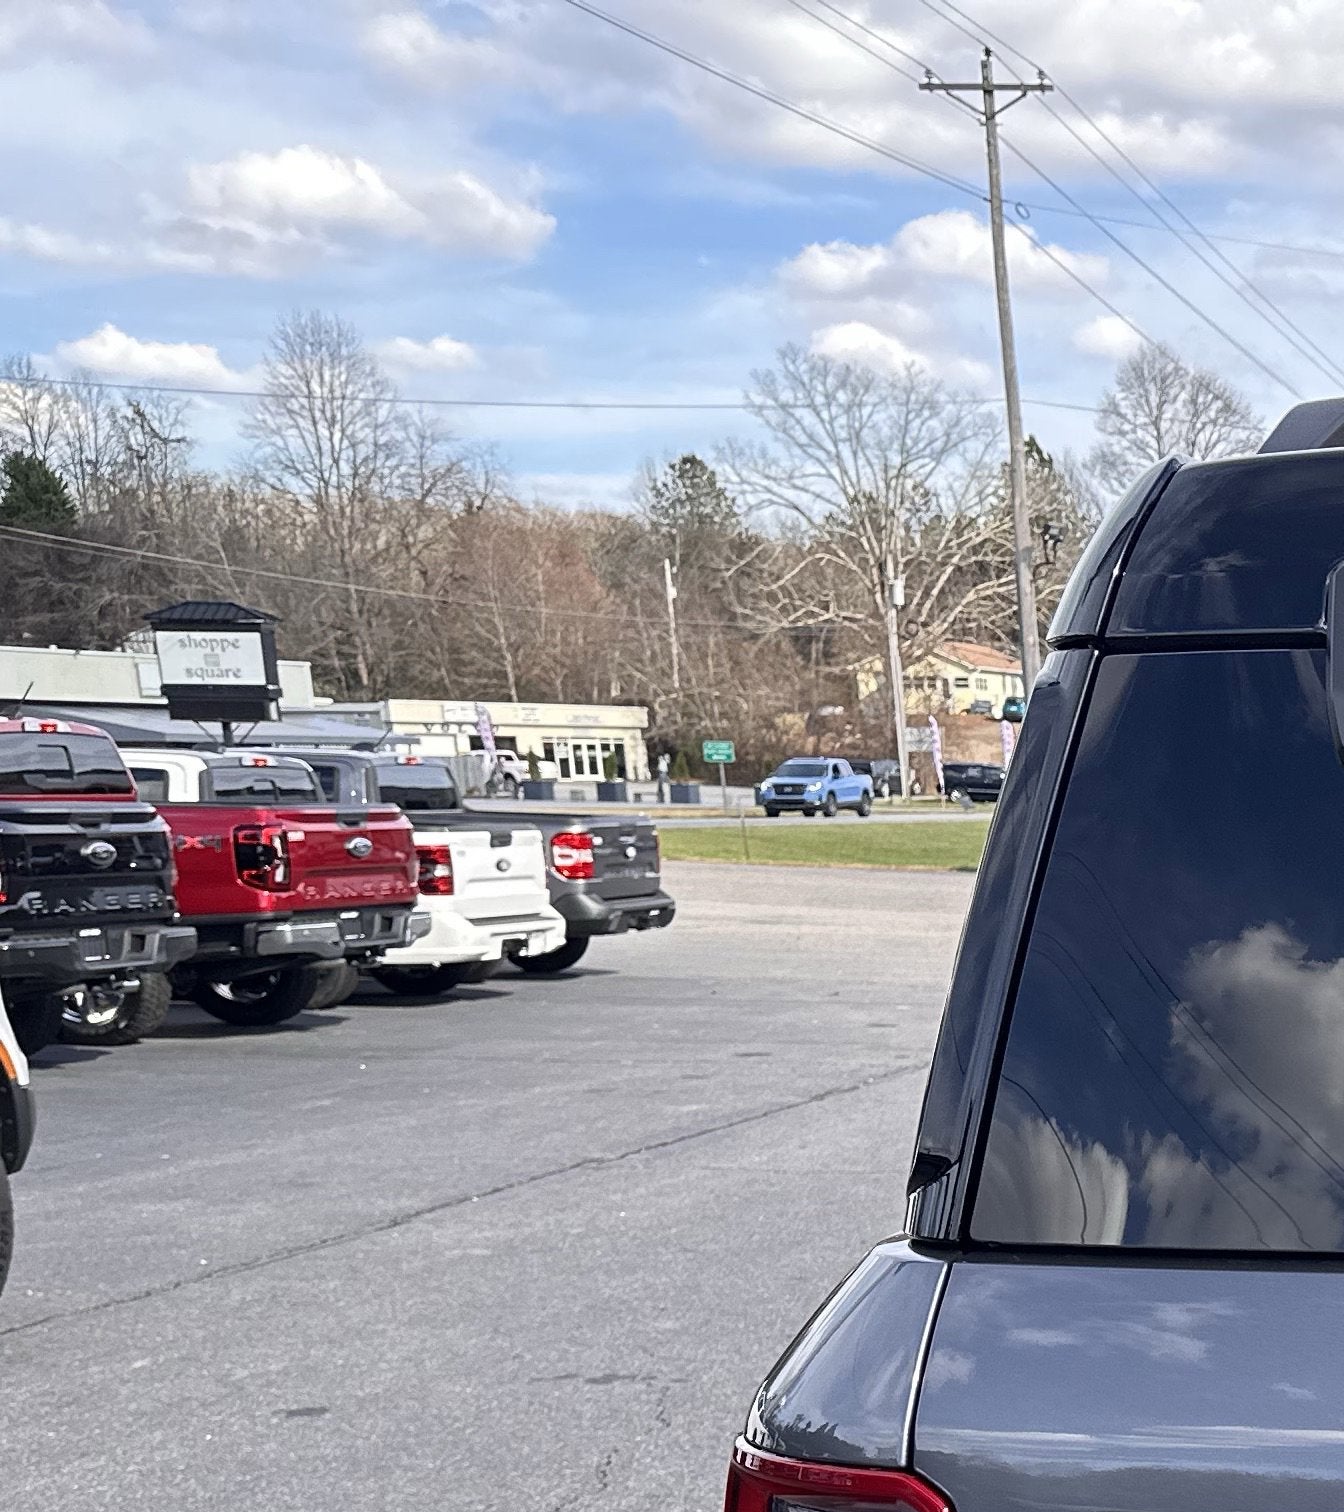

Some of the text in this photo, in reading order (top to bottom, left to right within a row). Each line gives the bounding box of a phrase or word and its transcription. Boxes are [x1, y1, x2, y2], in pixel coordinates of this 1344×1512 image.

[178, 634, 241, 652] shoppe
[184, 667, 242, 681] square
[304, 880, 408, 900] RANGER
[29, 891, 163, 914] RANGER
